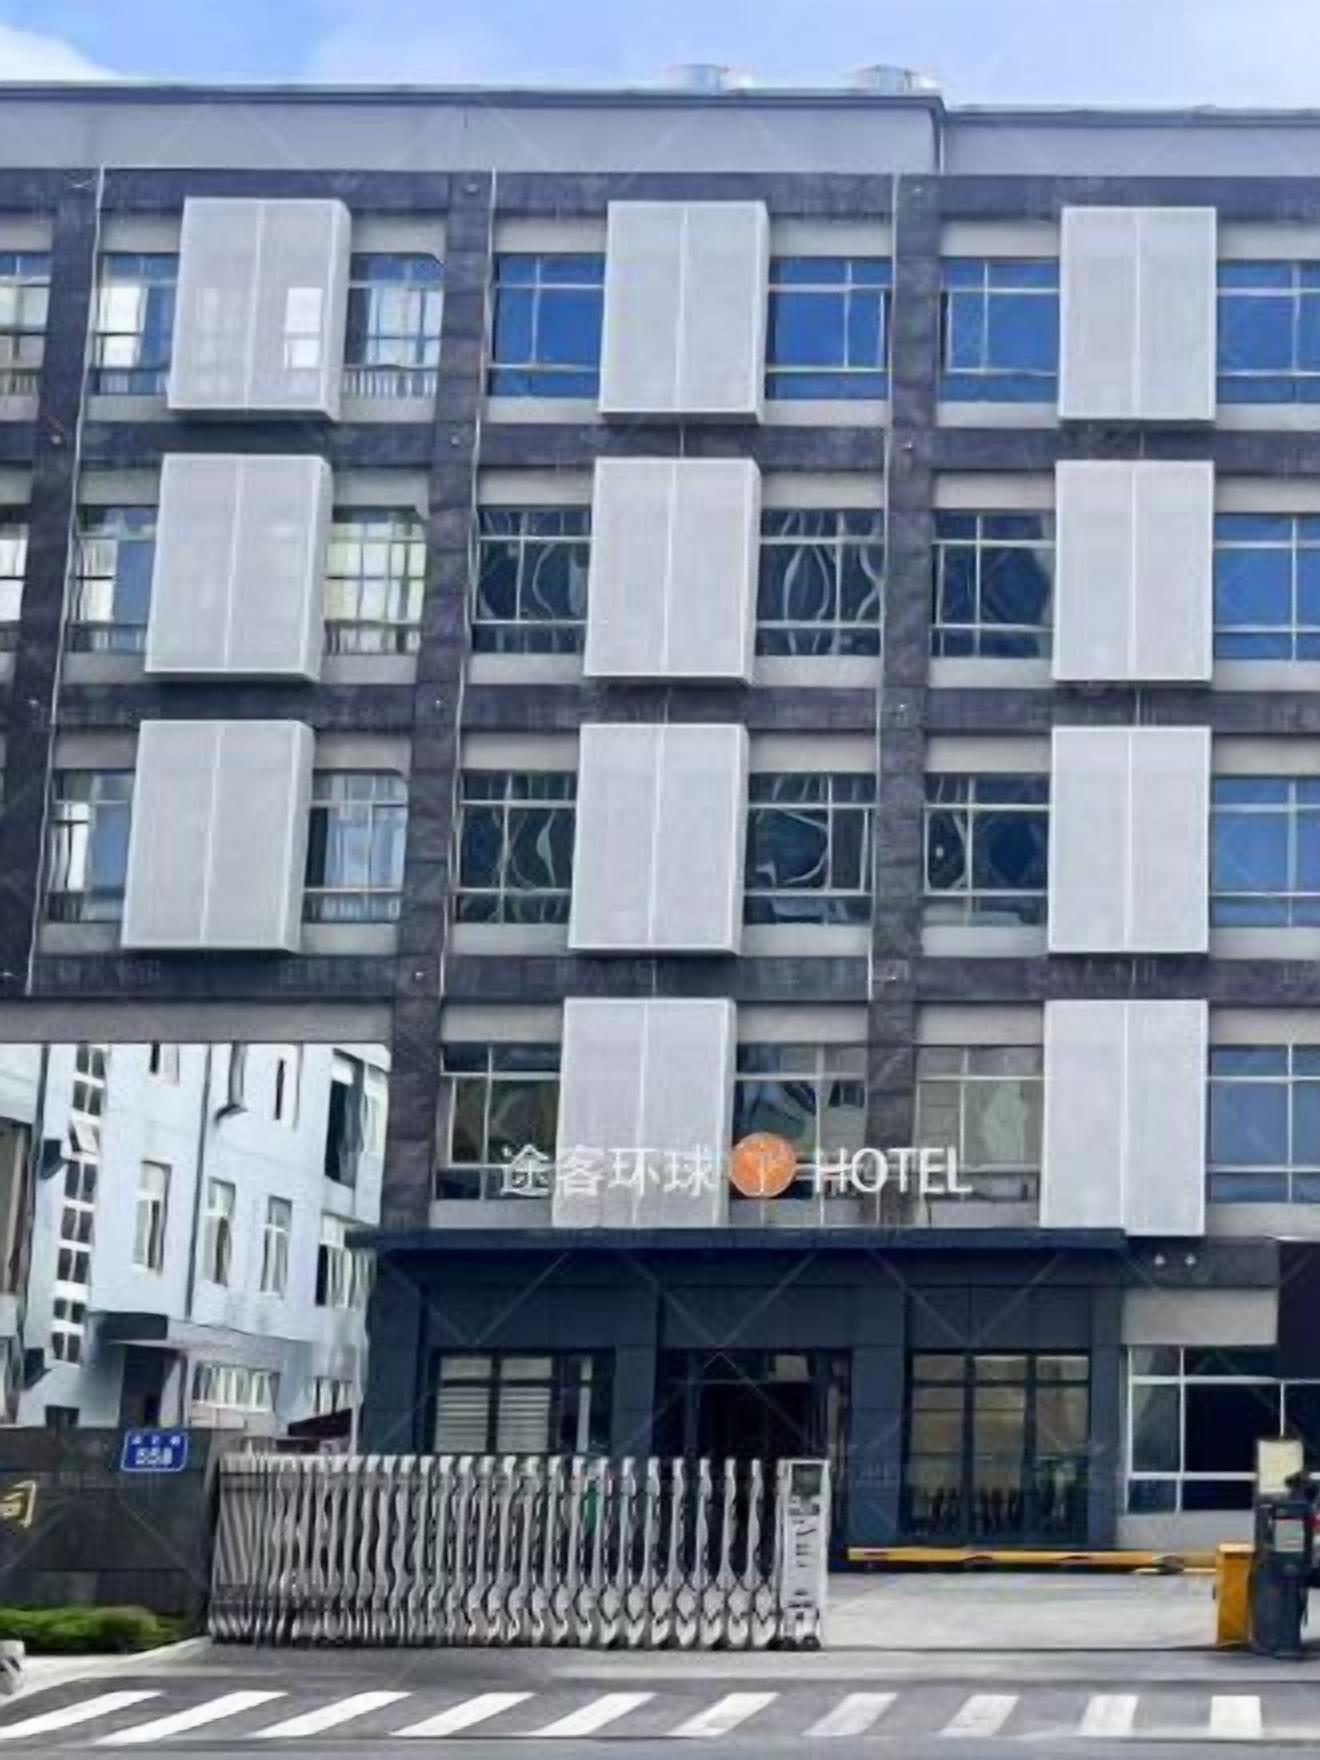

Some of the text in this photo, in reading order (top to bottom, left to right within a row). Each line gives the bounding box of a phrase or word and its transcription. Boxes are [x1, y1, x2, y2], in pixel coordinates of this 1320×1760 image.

[501, 1144, 973, 1196] 途客环球 HOTEL
